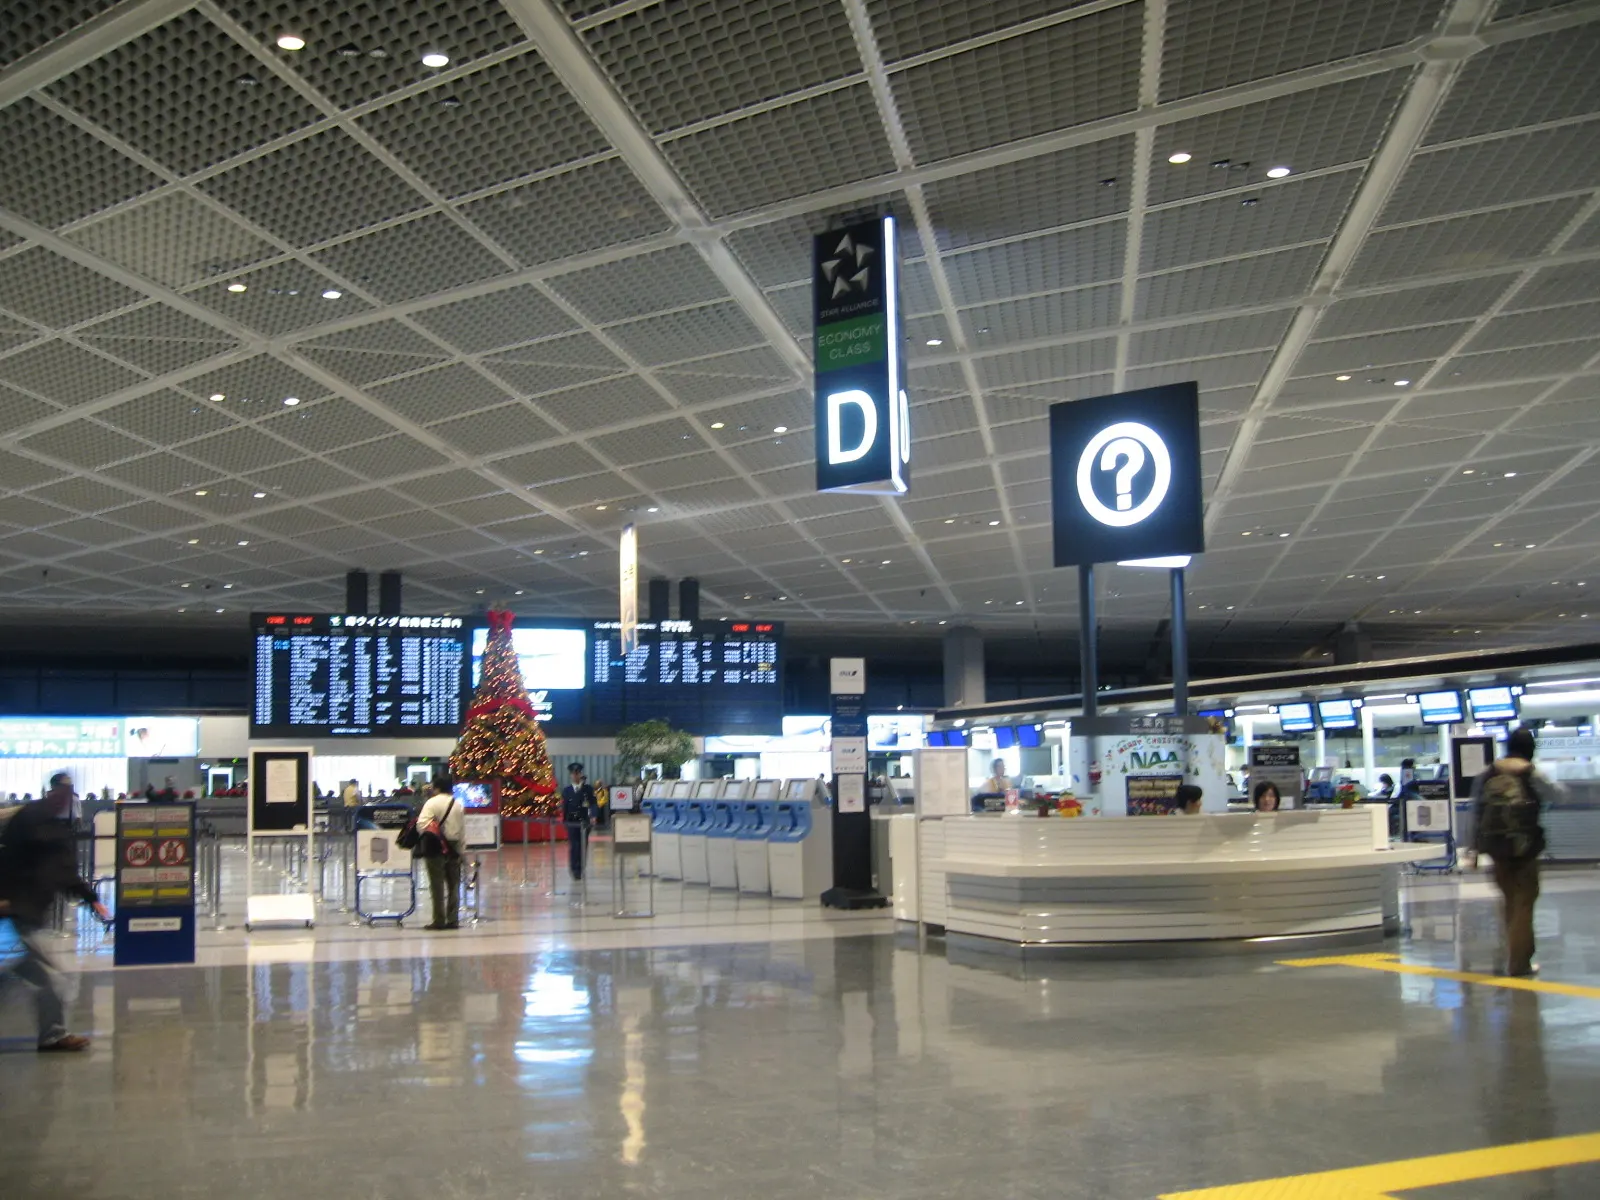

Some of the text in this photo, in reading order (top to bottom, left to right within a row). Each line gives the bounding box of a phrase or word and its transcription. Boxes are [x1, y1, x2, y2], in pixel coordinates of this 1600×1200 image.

[820, 298, 880, 319] STAR ALLIANCE
[818, 324, 880, 348] ECONOMY
[829, 341, 871, 360] CLASS
[827, 389, 878, 465] D
[1130, 717, 1164, 729] ご案内
[1130, 751, 1179, 769] NAA
